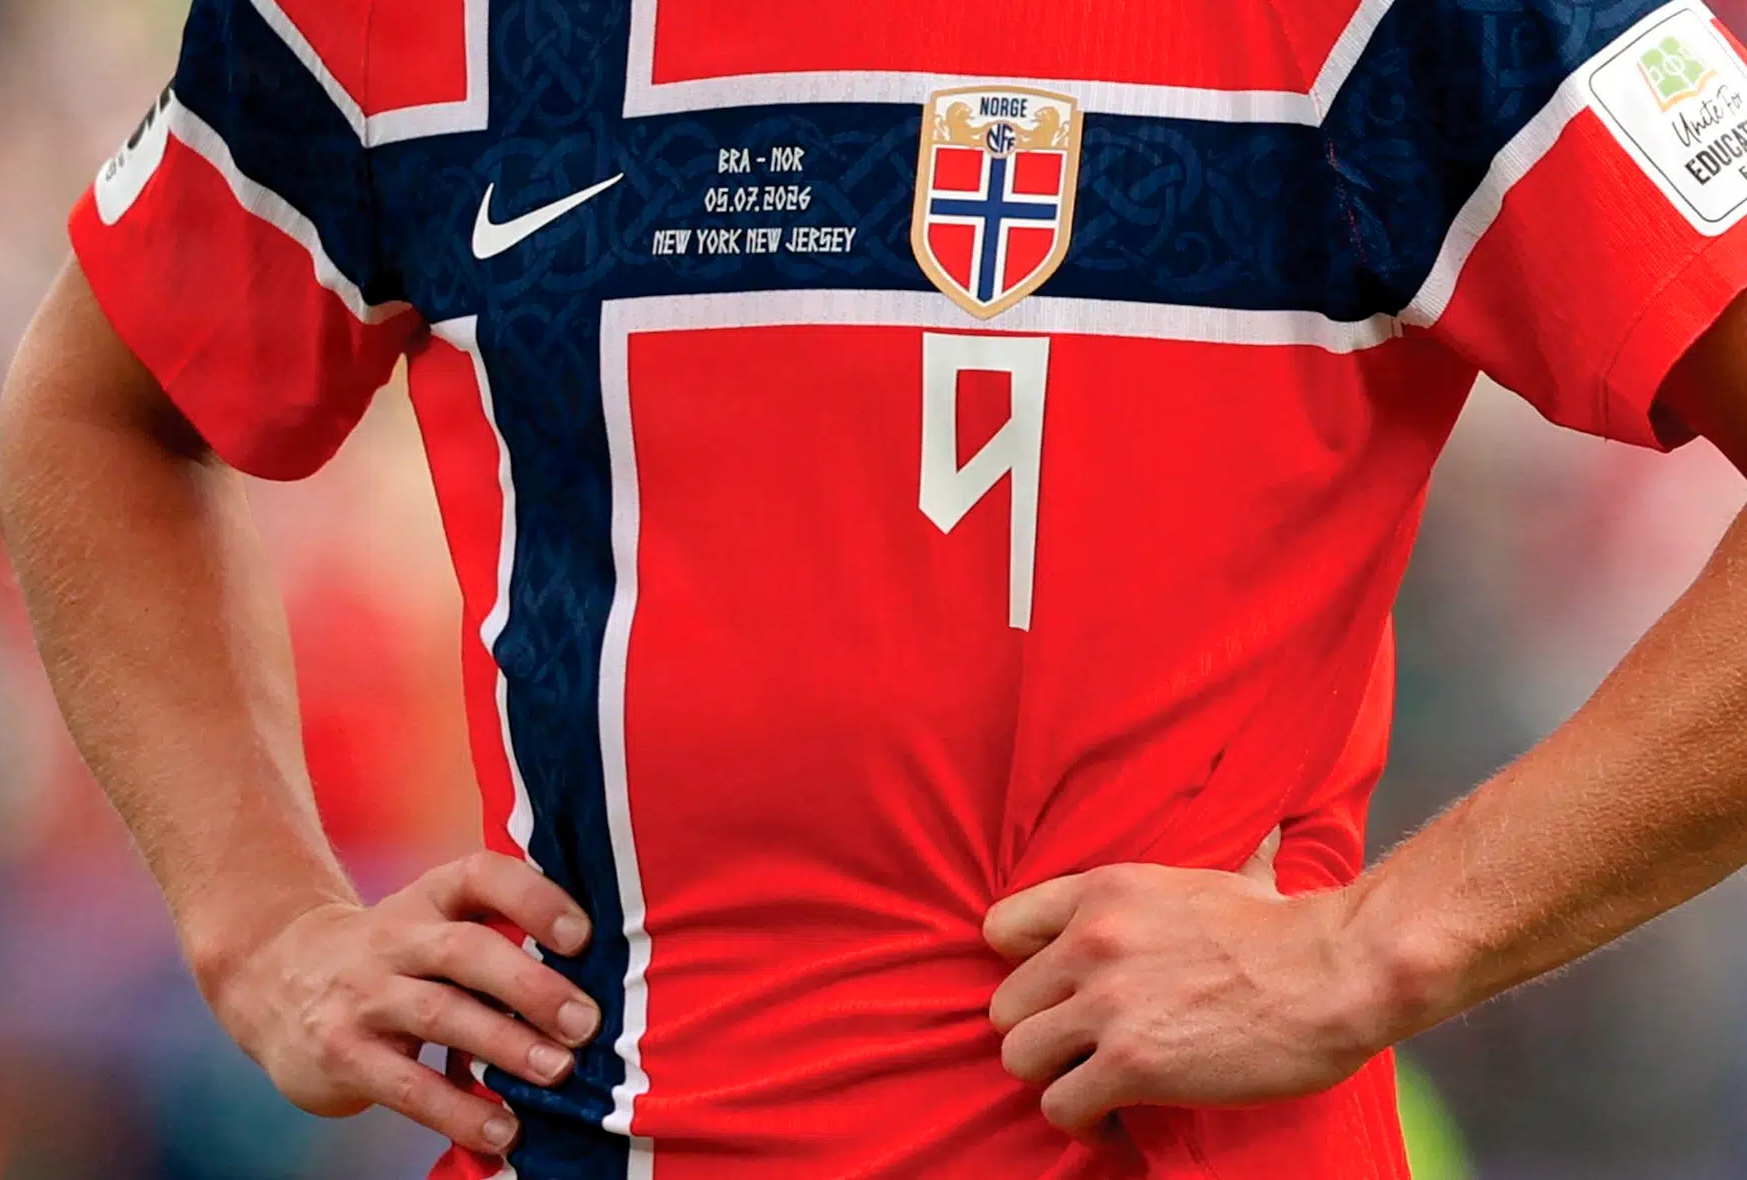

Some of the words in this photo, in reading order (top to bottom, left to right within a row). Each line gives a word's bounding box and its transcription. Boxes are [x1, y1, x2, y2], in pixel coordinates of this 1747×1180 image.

[980, 96, 1028, 118] NORGE
[1671, 100, 1724, 147] Unite
[718, 148, 751, 173] BRA
[770, 146, 805, 172] NOR
[704, 186, 812, 212] 05.07.2026
[652, 228, 692, 255] NEW
[696, 228, 743, 255] YORK
[745, 227, 783, 254] NEW
[785, 227, 857, 253] JERSEY
[918, 330, 1051, 633] 9
